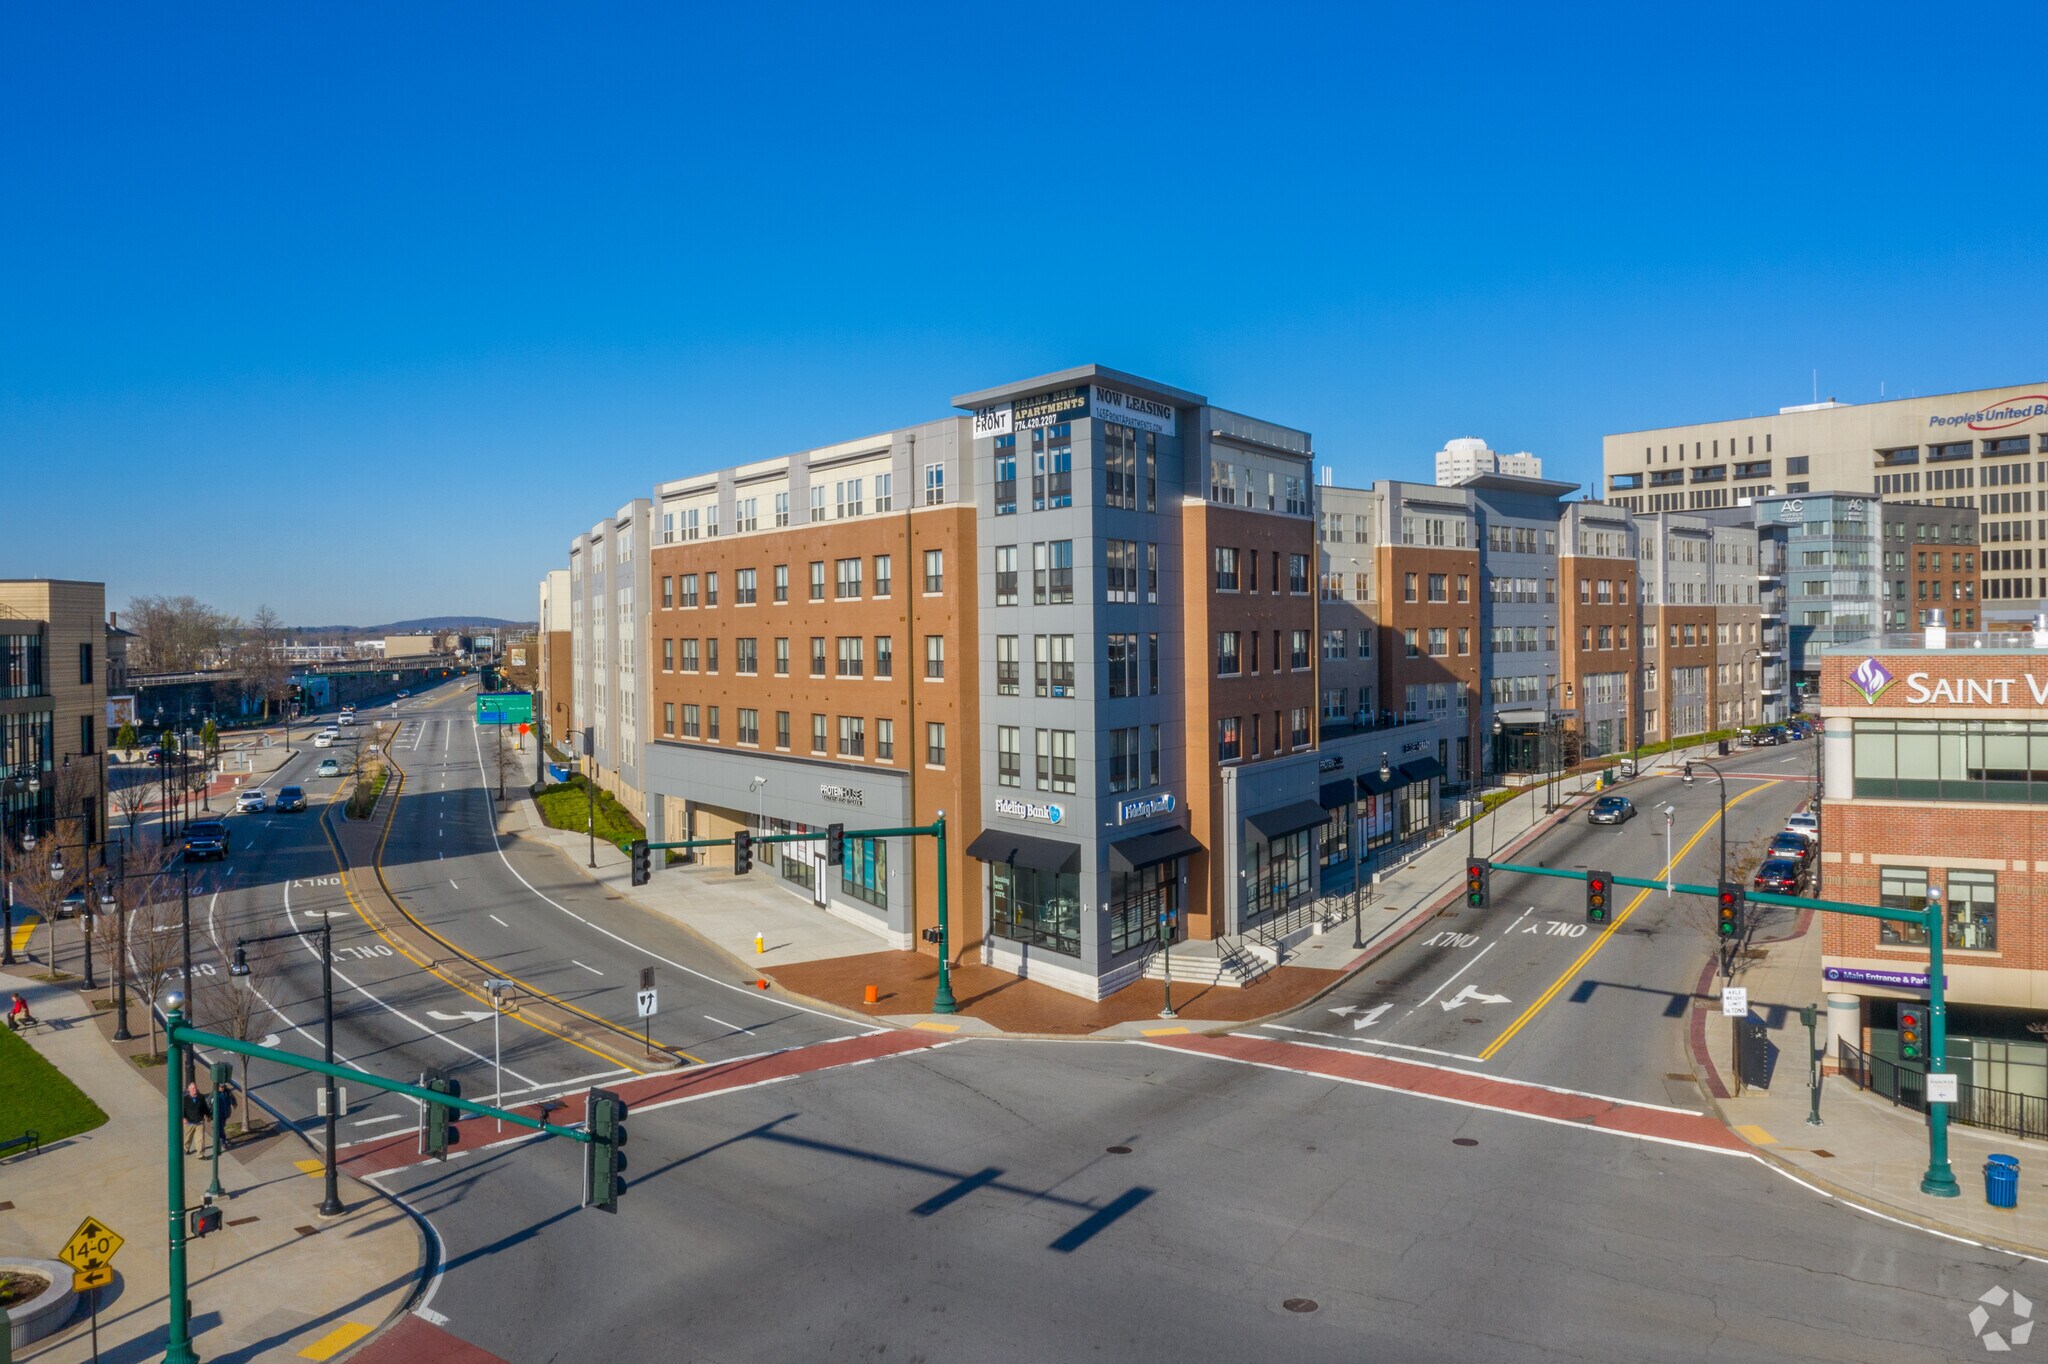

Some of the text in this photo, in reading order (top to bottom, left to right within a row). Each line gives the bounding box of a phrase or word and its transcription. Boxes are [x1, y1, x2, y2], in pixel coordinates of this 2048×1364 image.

[1014, 387, 1077, 410] BRAND NEW
[1096, 387, 1171, 420] NOW LEASING
[975, 405, 997, 421] 145
[1015, 397, 1085, 420] APARTMENTS
[1929, 411, 1984, 427] People's
[1986, 405, 2032, 421] United
[975, 413, 1006, 433] FRONT
[1780, 499, 1804, 513] AC
[1848, 499, 1863, 511] AC
[1905, 672, 2016, 704] SAINT
[995, 799, 1050, 819] Fidelity Bank
[293, 877, 340, 888] ONLY
[1522, 921, 1588, 938] ONLY
[1422, 931, 1480, 948] ONLY
[330, 945, 393, 962] ONLY
[1843, 970, 1864, 980] Main
[1866, 972, 1901, 983] Entrance
[1902, 975, 1910, 984] &
